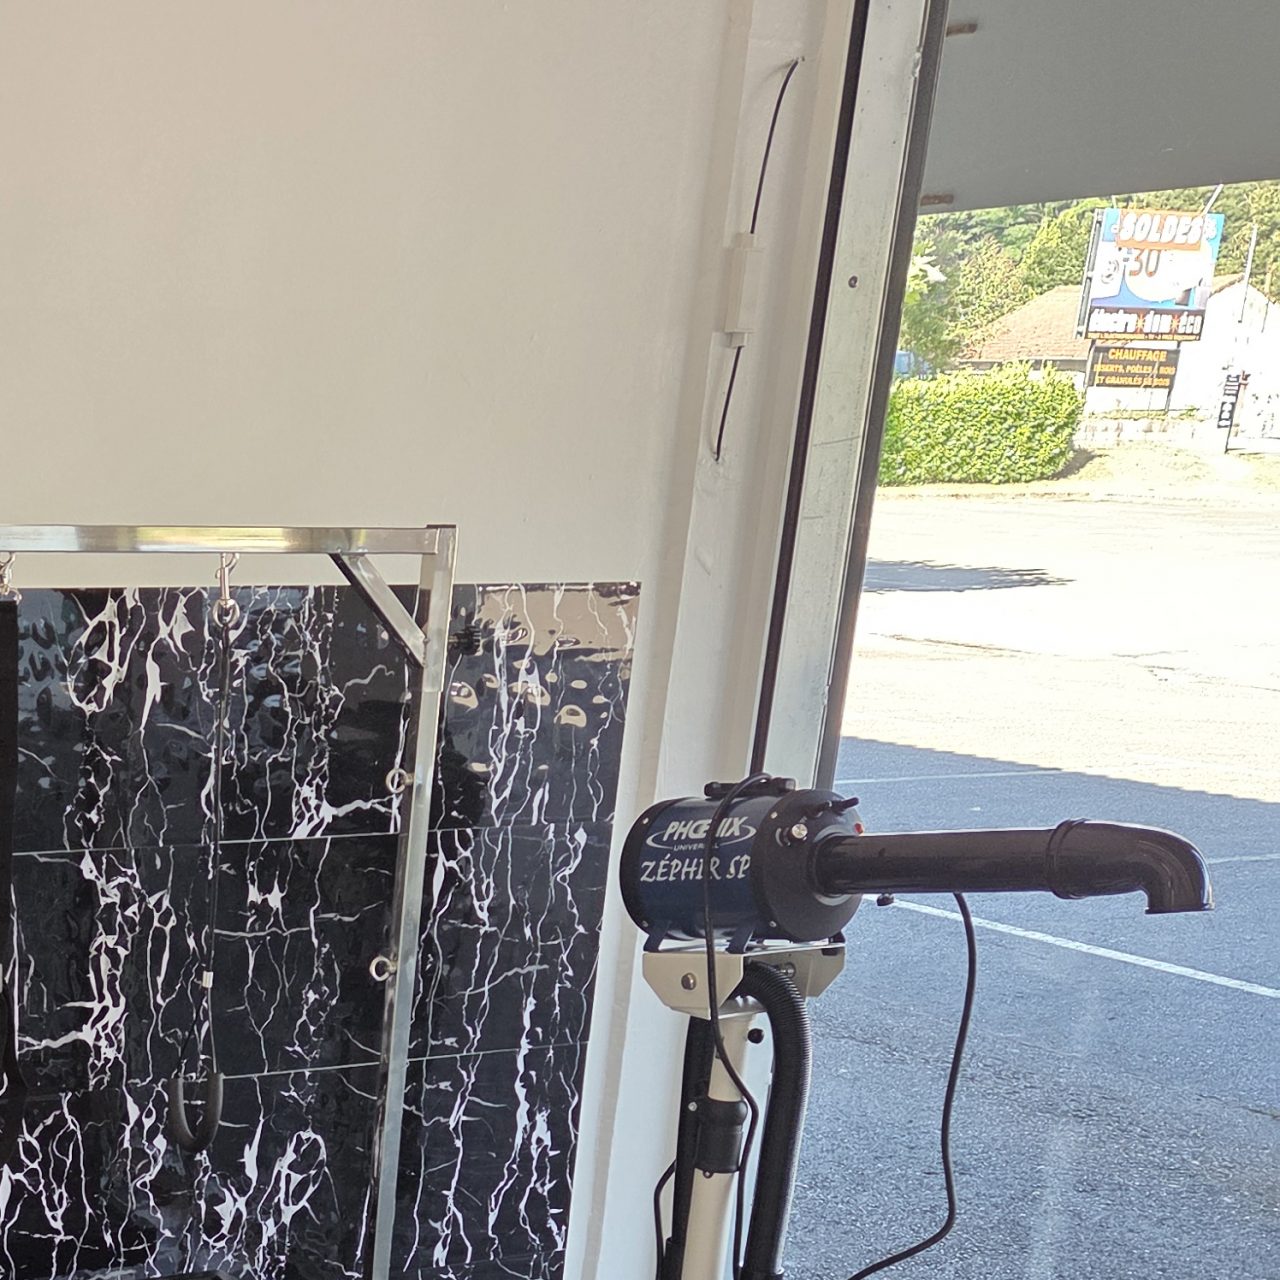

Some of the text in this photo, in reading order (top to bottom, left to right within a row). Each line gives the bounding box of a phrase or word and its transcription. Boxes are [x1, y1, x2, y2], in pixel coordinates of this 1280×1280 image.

[1120, 212, 1203, 245] SOLDES
[1108, 348, 1167, 362] CHAUFFAGE
[673, 842, 720, 851] UNIVERL
[640, 853, 751, 882] ZÉPHIR SP
